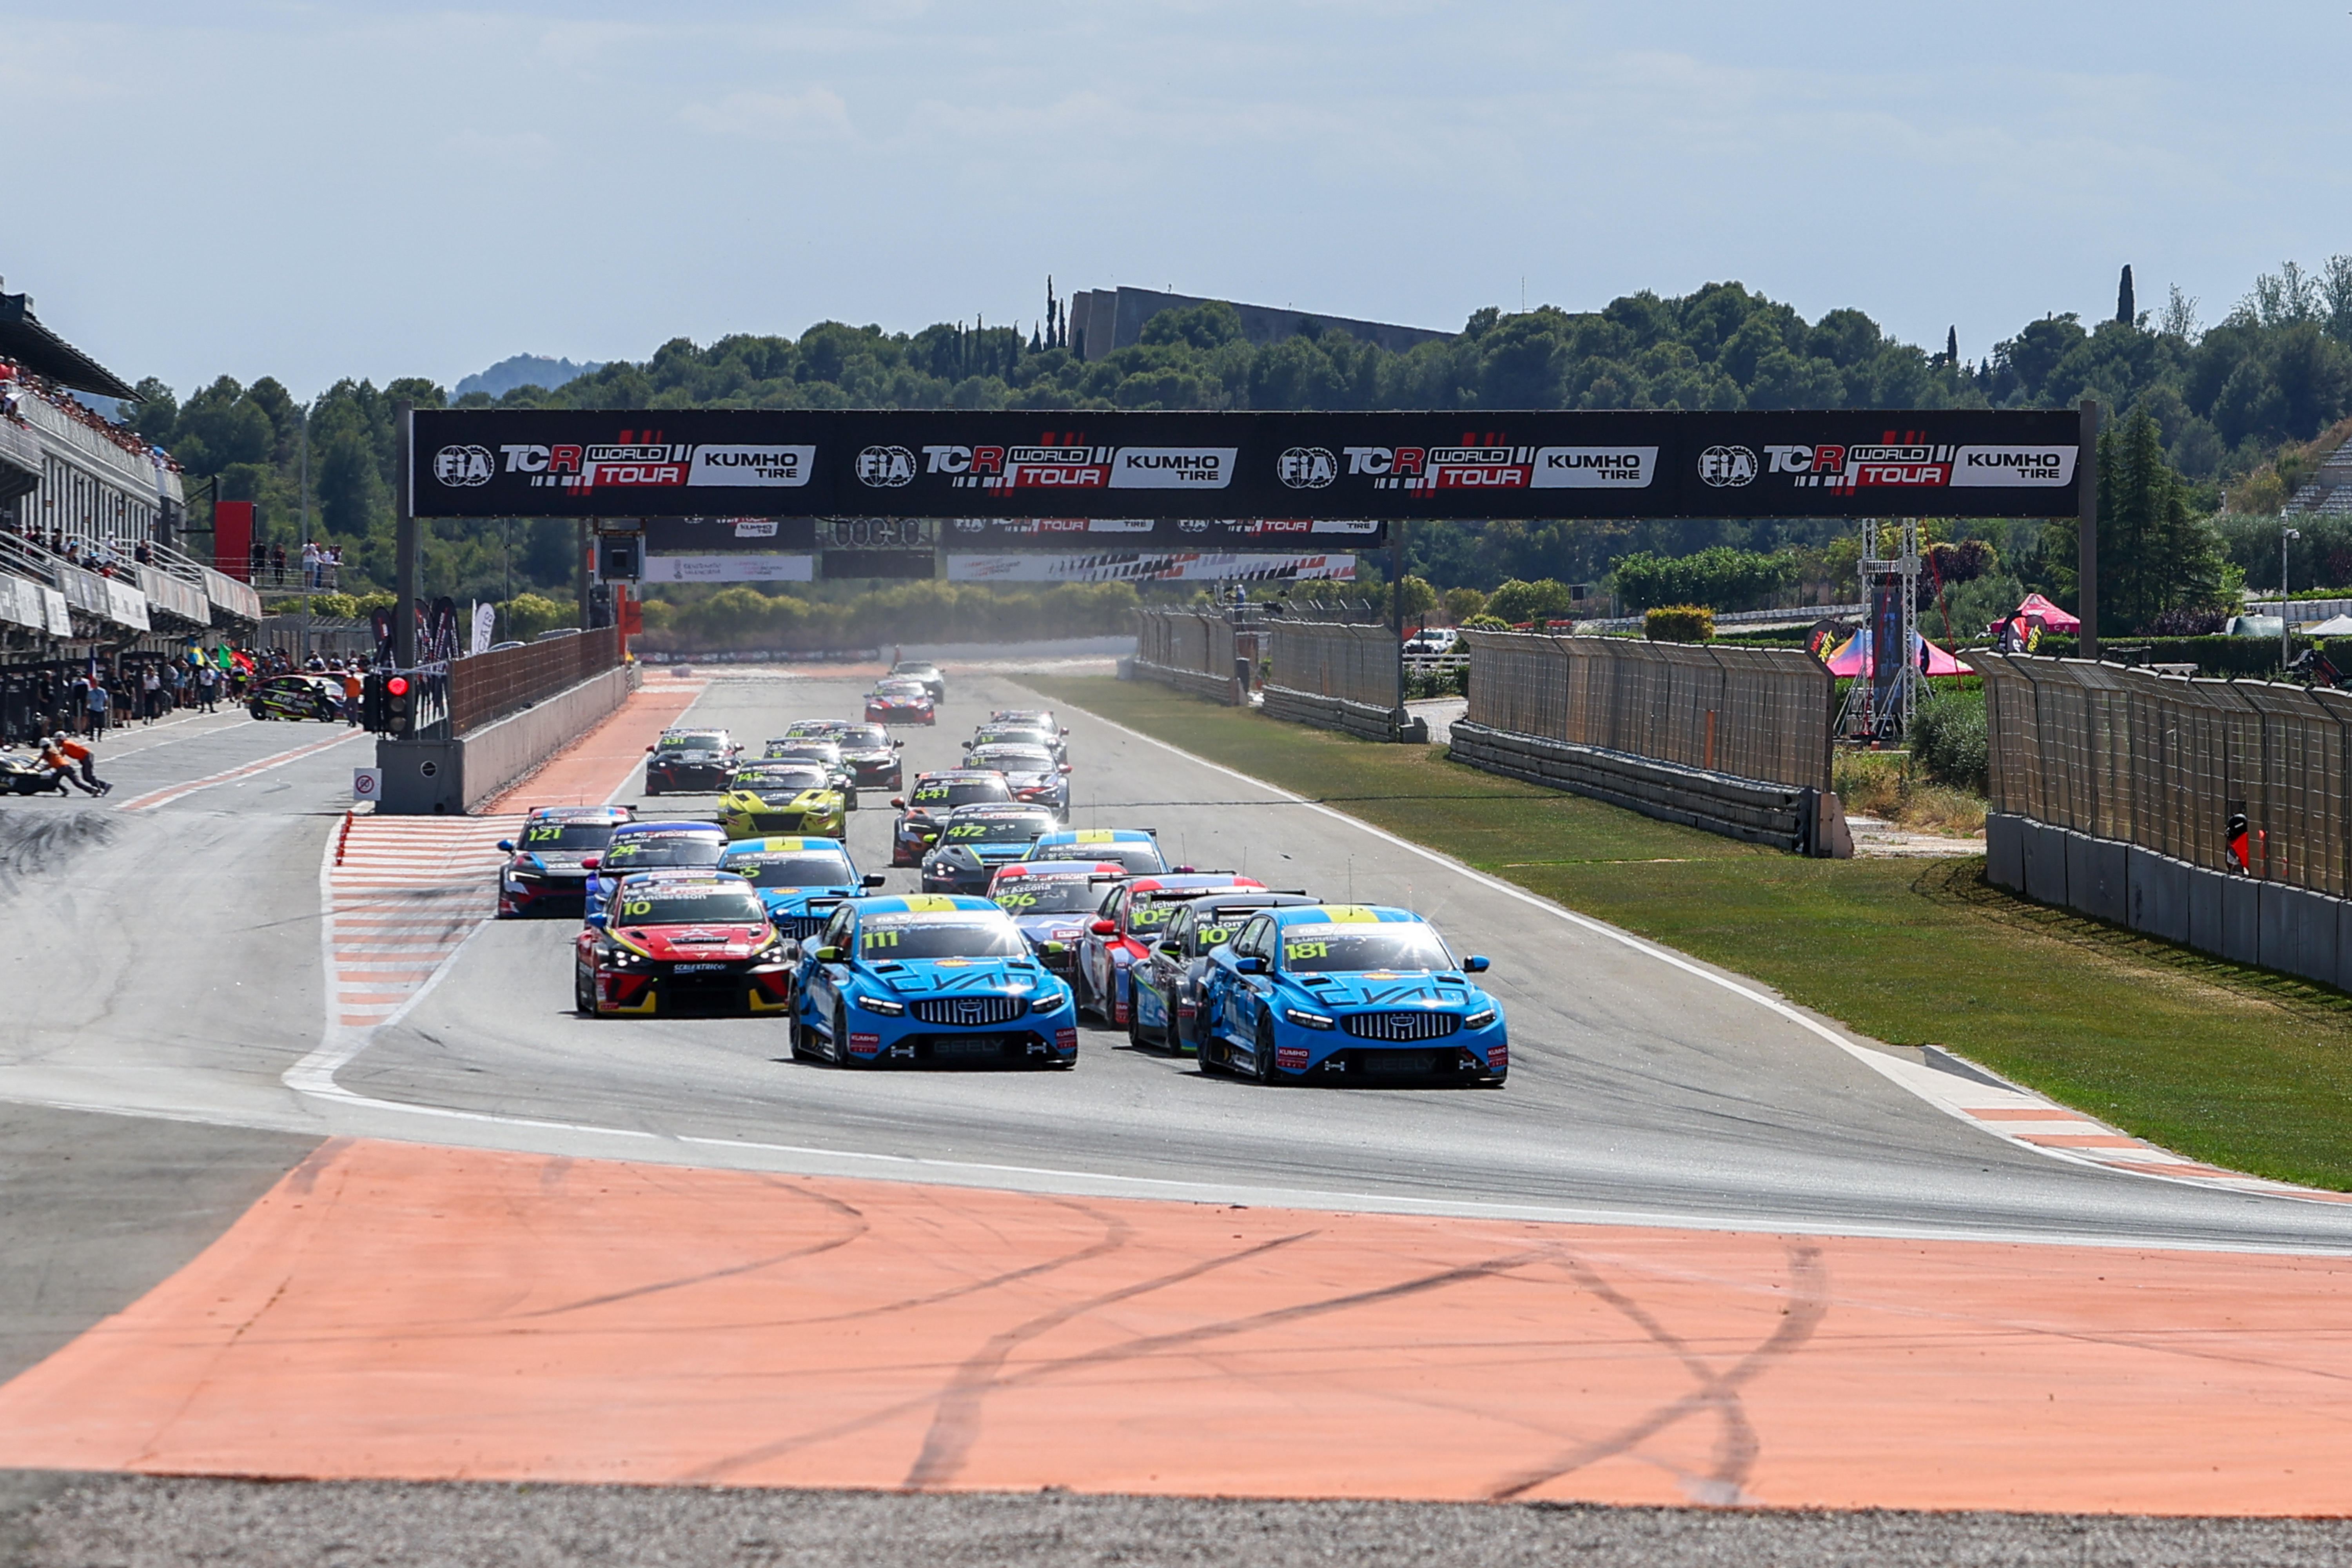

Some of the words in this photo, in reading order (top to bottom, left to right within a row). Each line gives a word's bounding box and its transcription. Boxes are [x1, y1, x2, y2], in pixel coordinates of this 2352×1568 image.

[500, 445, 580, 472] TCR
[592, 448, 662, 460] WORLD
[705, 453, 798, 466] KUMHO
[922, 446, 1003, 473] TCR
[1013, 450, 1084, 463] WORLD
[1343, 447, 1425, 474] TCR
[1434, 450, 1505, 463] WORLD
[1764, 445, 1844, 472] TCR
[1855, 449, 1925, 461] WORLD
[1967, 453, 2061, 466] KUMHO
[1125, 456, 1220, 468] KUMHO
[1547, 455, 1641, 468] KUMHO
[602, 468, 679, 483] TOUR
[755, 469, 798, 479] TIRE
[1022, 468, 1101, 485] TOUR
[1176, 471, 1220, 481] TIRE
[1444, 469, 1521, 485] TOUR
[1597, 470, 1641, 480] TIRE
[1865, 467, 1942, 483] TOUR
[2017, 469, 2060, 479] TIRE
[1044, 521, 1084, 530] TOUR
[1265, 521, 1307, 531] TOUR
[915, 789, 949, 800] 441
[529, 829, 562, 841] 121
[947, 826, 987, 837] 472
[608, 844, 635, 858] 24
[1011, 884, 1051, 894] Azcona
[993, 893, 1036, 907] 196
[623, 901, 651, 915] 10
[1130, 907, 1175, 926] 105
[862, 931, 898, 949] 111
[1285, 942, 1327, 960] 181
[934, 1039, 1005, 1053] GEELY
[1365, 1058, 1437, 1070] GEELY
